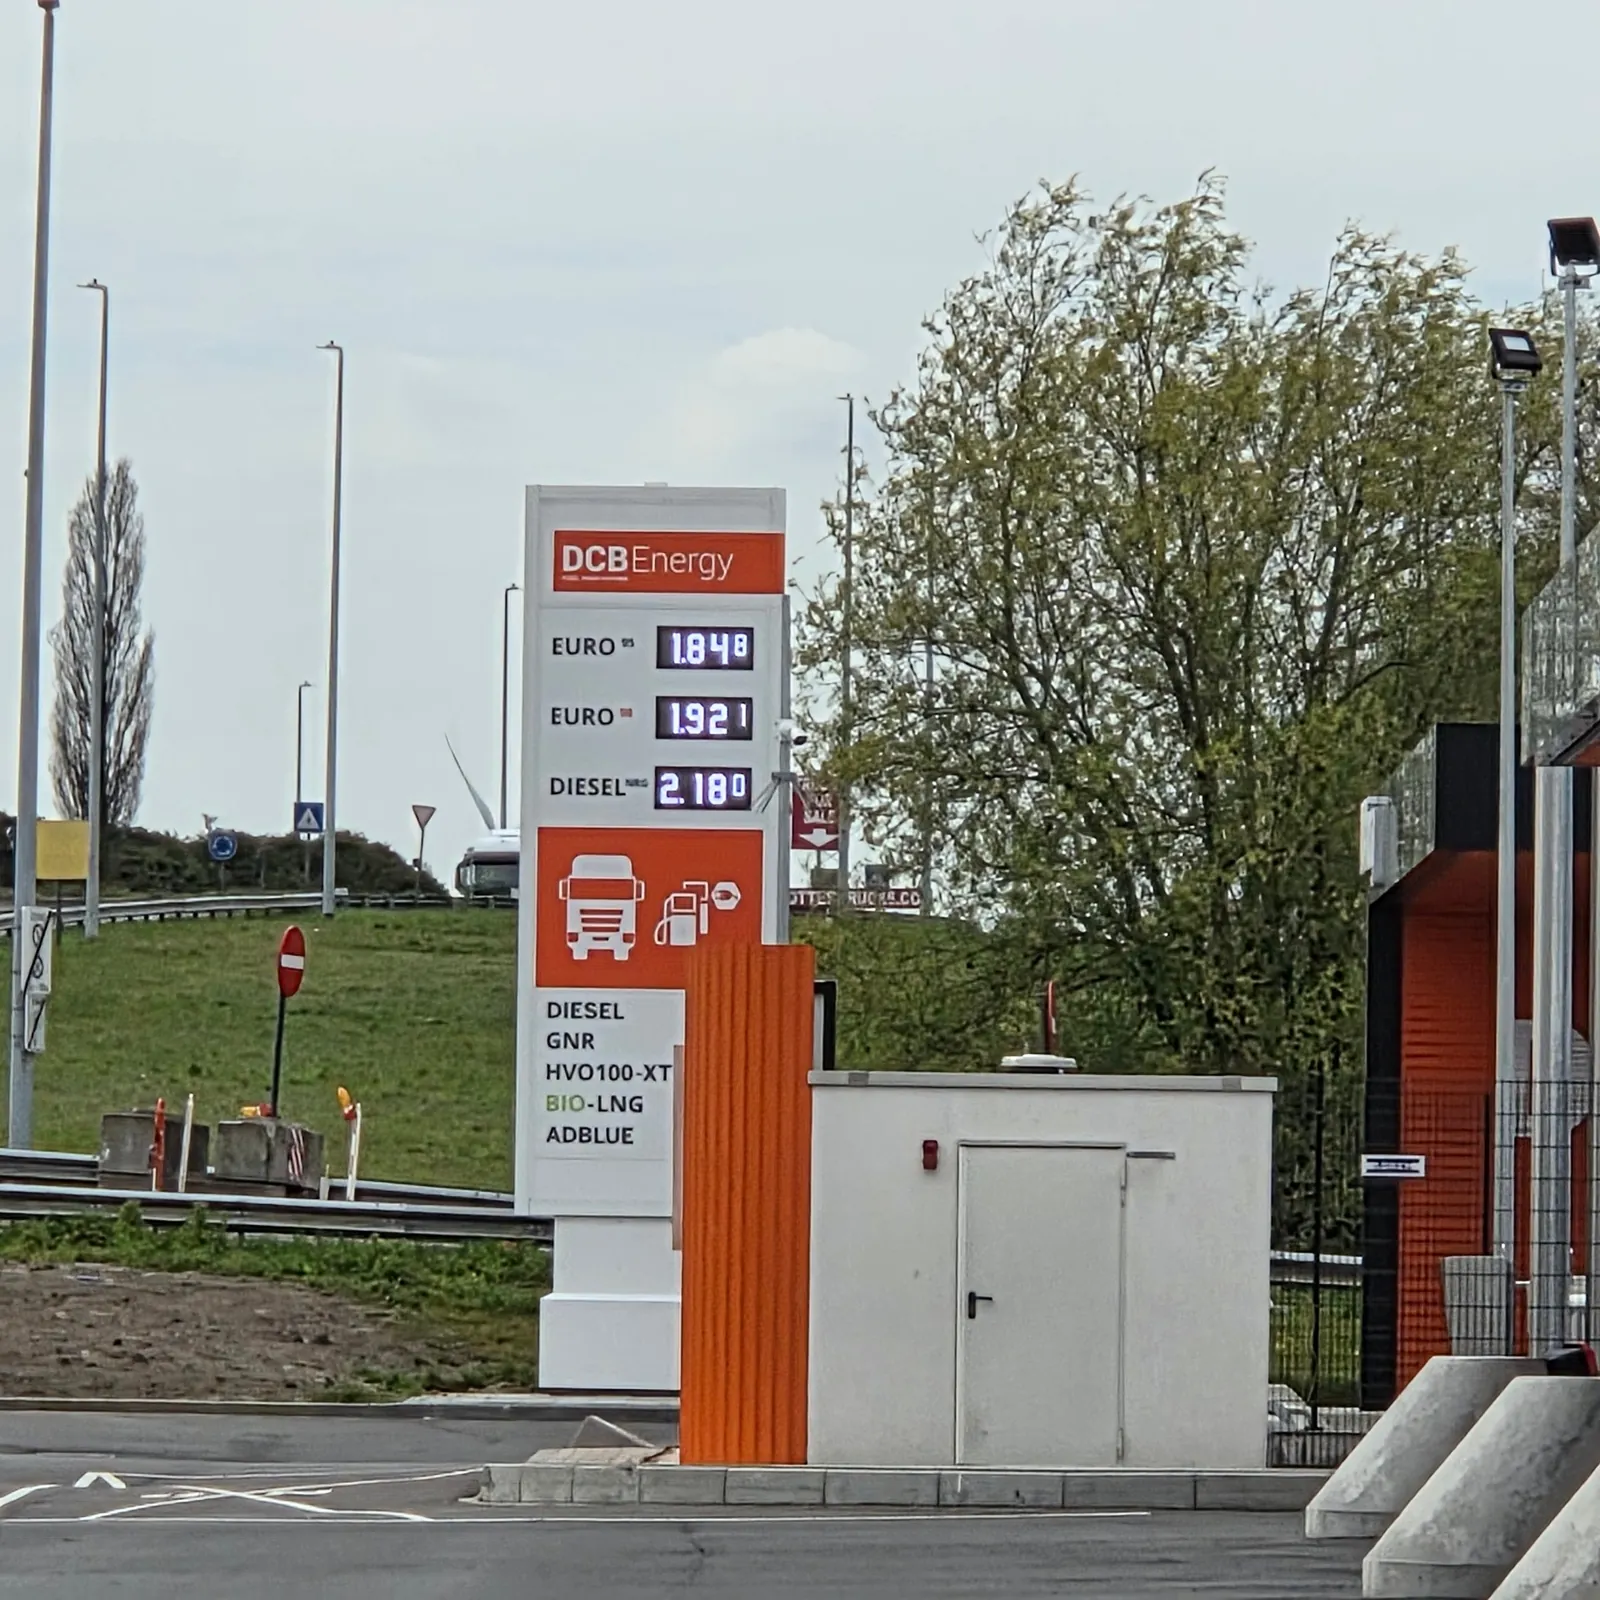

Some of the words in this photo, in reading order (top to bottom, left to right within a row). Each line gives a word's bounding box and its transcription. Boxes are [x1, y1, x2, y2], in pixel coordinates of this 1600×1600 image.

[562, 545, 628, 572] DCB
[632, 546, 734, 581] Energy
[552, 637, 615, 656] EURO
[551, 707, 614, 726] EURO
[550, 777, 627, 796] DIESEL
[547, 1001, 625, 1020] DIESEL
[546, 1032, 595, 1050] GNR
[546, 1063, 673, 1082] HVO100-XT
[546, 1094, 644, 1113] BIO-LNG
[546, 1126, 635, 1145] ADBLUE
